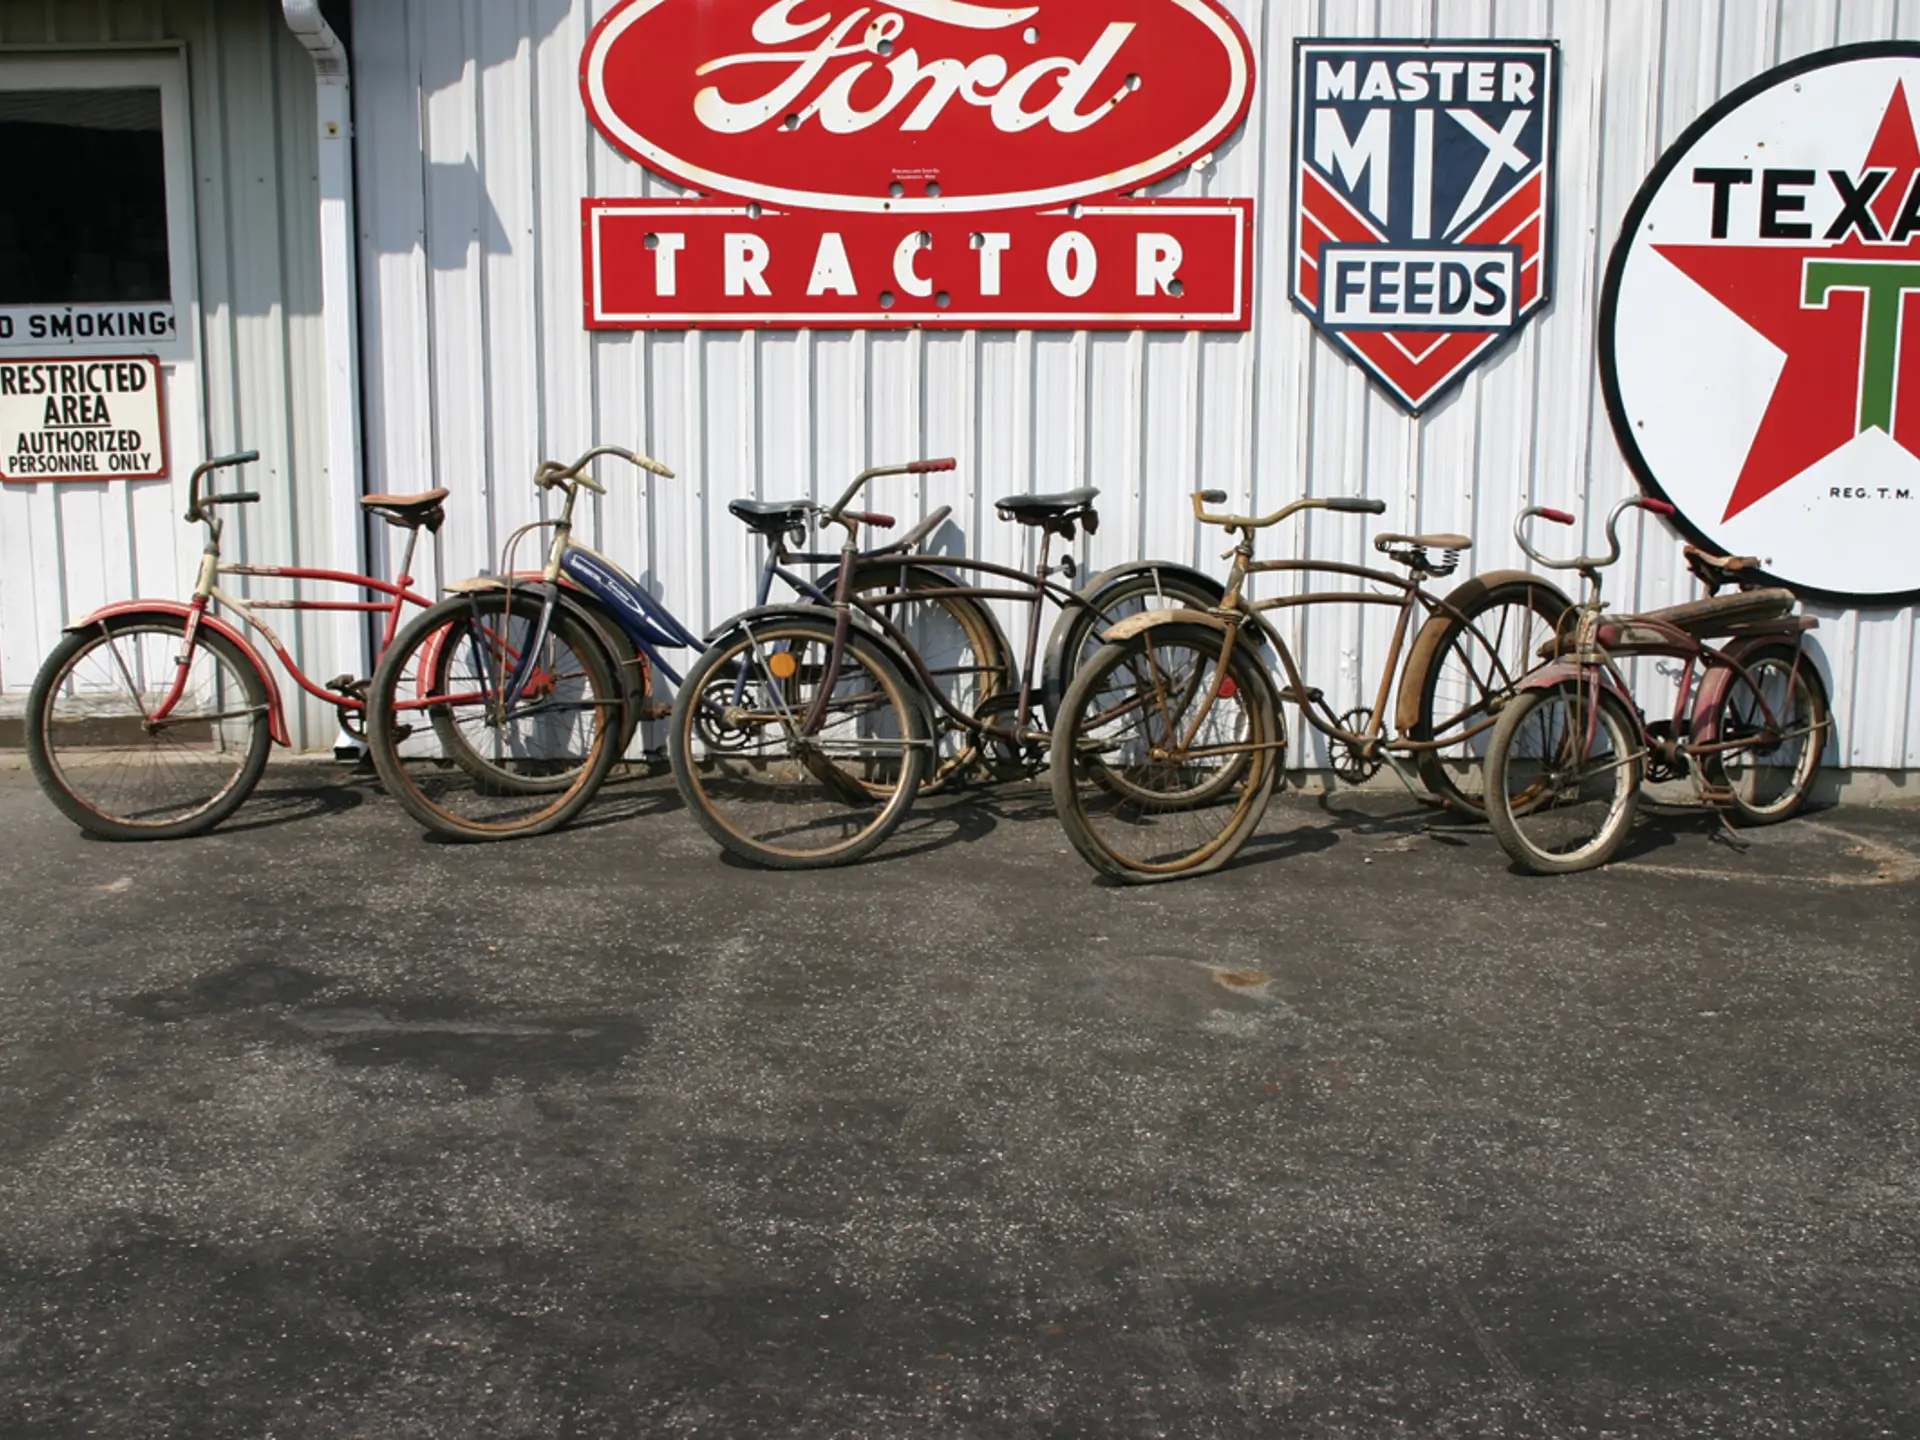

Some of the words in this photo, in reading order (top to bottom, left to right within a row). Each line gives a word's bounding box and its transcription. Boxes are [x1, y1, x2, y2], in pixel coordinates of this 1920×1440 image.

[694, 0, 1137, 133] Ford
[1315, 60, 1536, 105] MASTER
[1314, 107, 1533, 240] MIX
[643, 230, 1184, 297] TRACTOR
[1335, 260, 1507, 316] FEEDS
[29, 311, 166, 338] SMOKING
[1, 363, 147, 394] RESTRICTED
[44, 394, 111, 424] AREA
[17, 430, 141, 453] AUTHORIZED
[9, 454, 99, 473] PERSONNEL
[108, 453, 151, 471] ONLY
[1829, 487, 1871, 499] REG.
